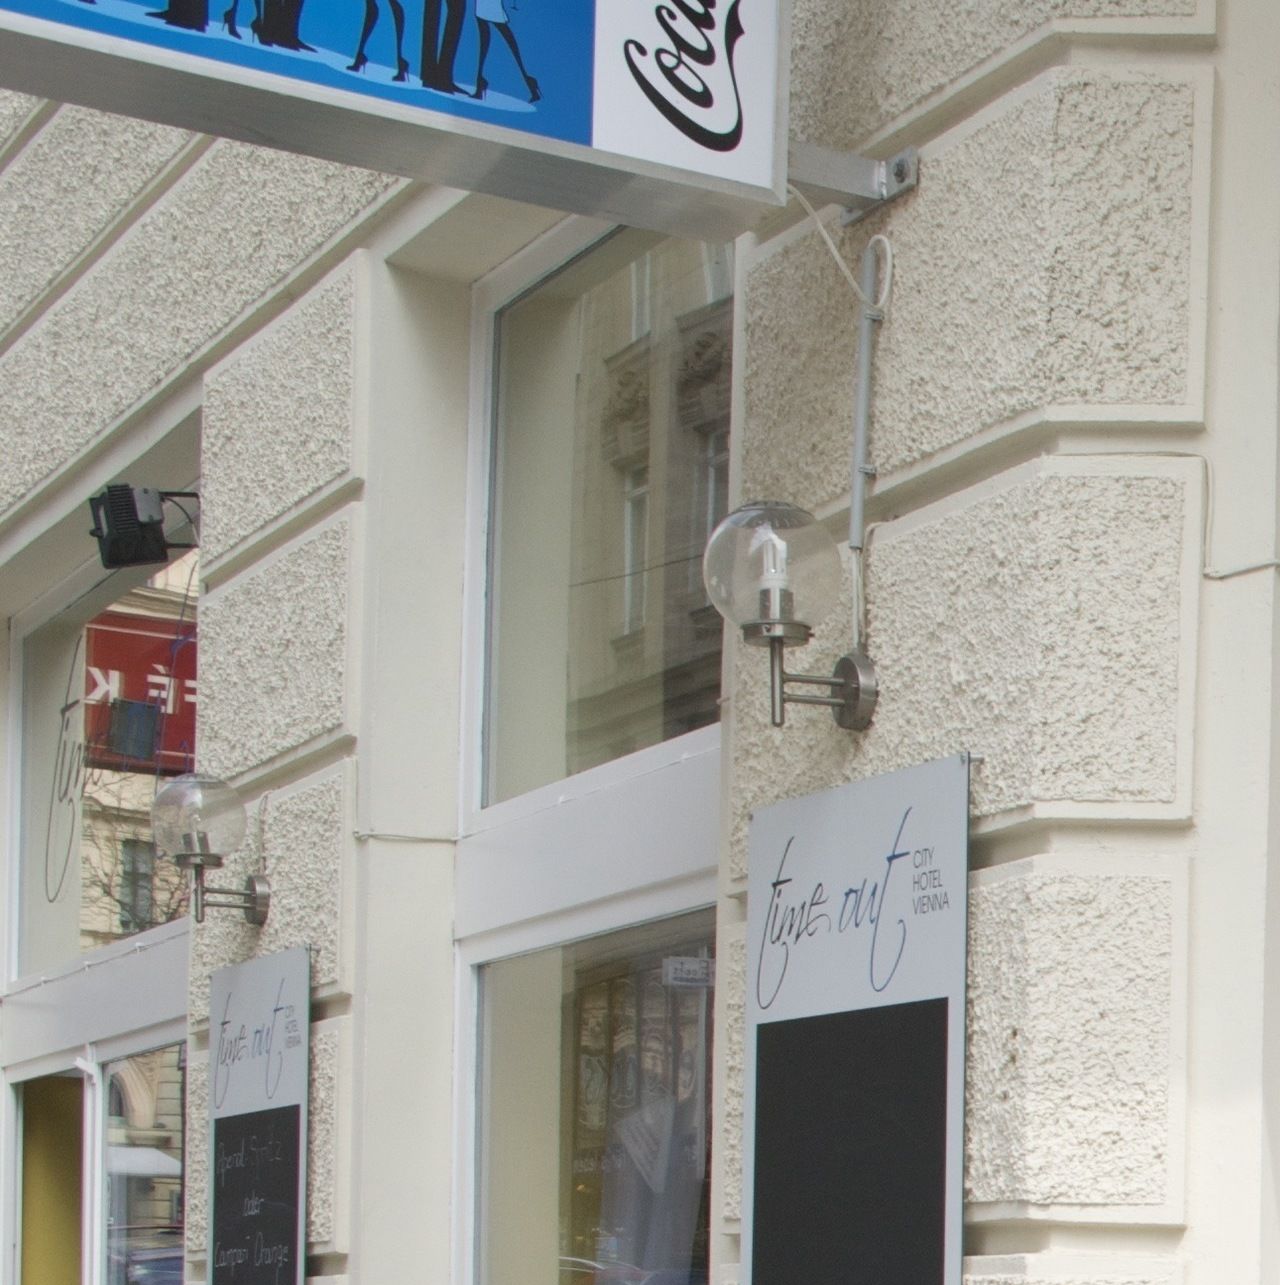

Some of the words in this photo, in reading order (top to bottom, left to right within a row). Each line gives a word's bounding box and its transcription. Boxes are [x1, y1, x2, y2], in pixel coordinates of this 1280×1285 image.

[912, 847, 935, 868] CITY
[912, 869, 943, 892] HOTEL
[757, 836, 832, 1010] time
[839, 806, 912, 992] out
[912, 891, 950, 916] VIENNA
